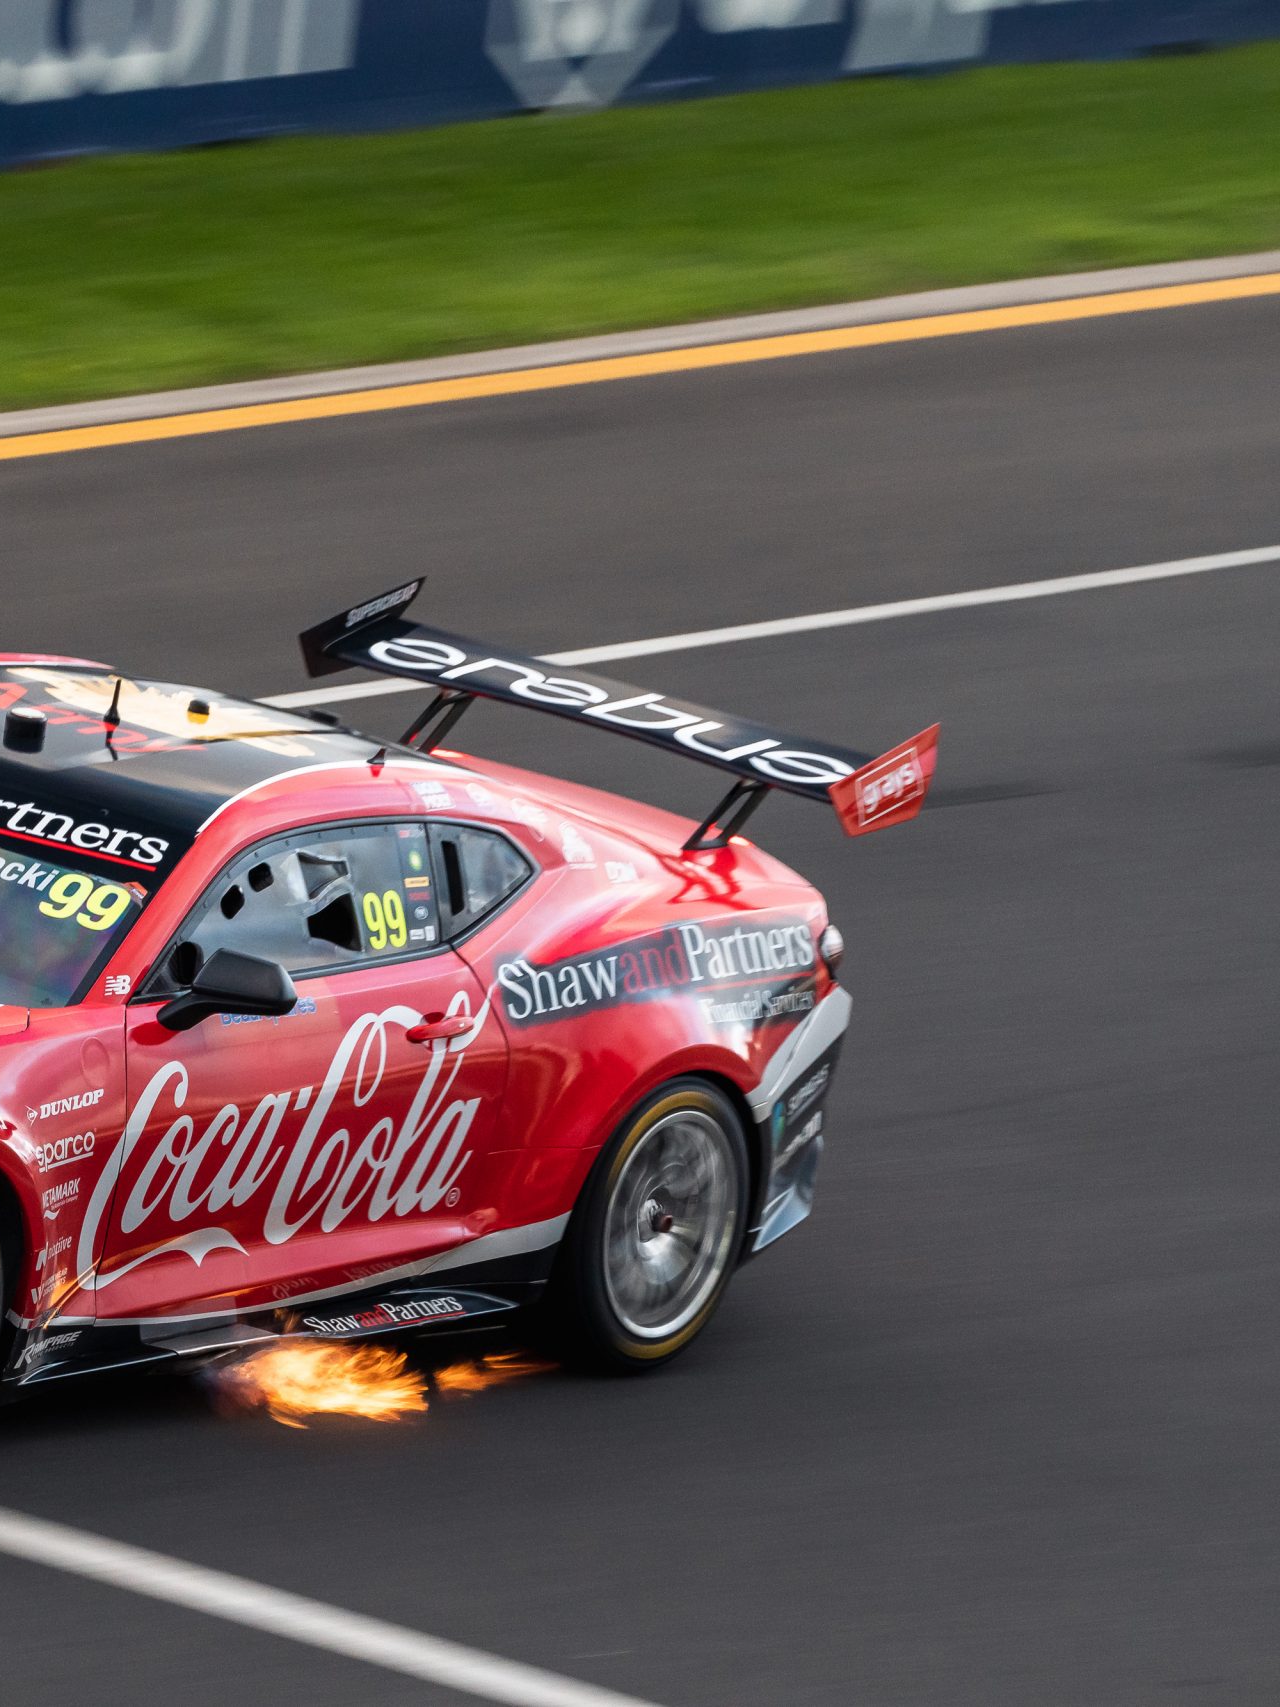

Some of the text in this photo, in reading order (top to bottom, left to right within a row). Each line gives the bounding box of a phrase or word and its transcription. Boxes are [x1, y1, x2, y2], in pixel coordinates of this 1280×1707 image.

[369, 637, 856, 784] erebus
[862, 761, 917, 815] grays
[38, 873, 132, 932] 99
[362, 889, 408, 950] 99
[39, 1088, 105, 1119] DUNLOP
[35, 1130, 96, 1173] sparco
